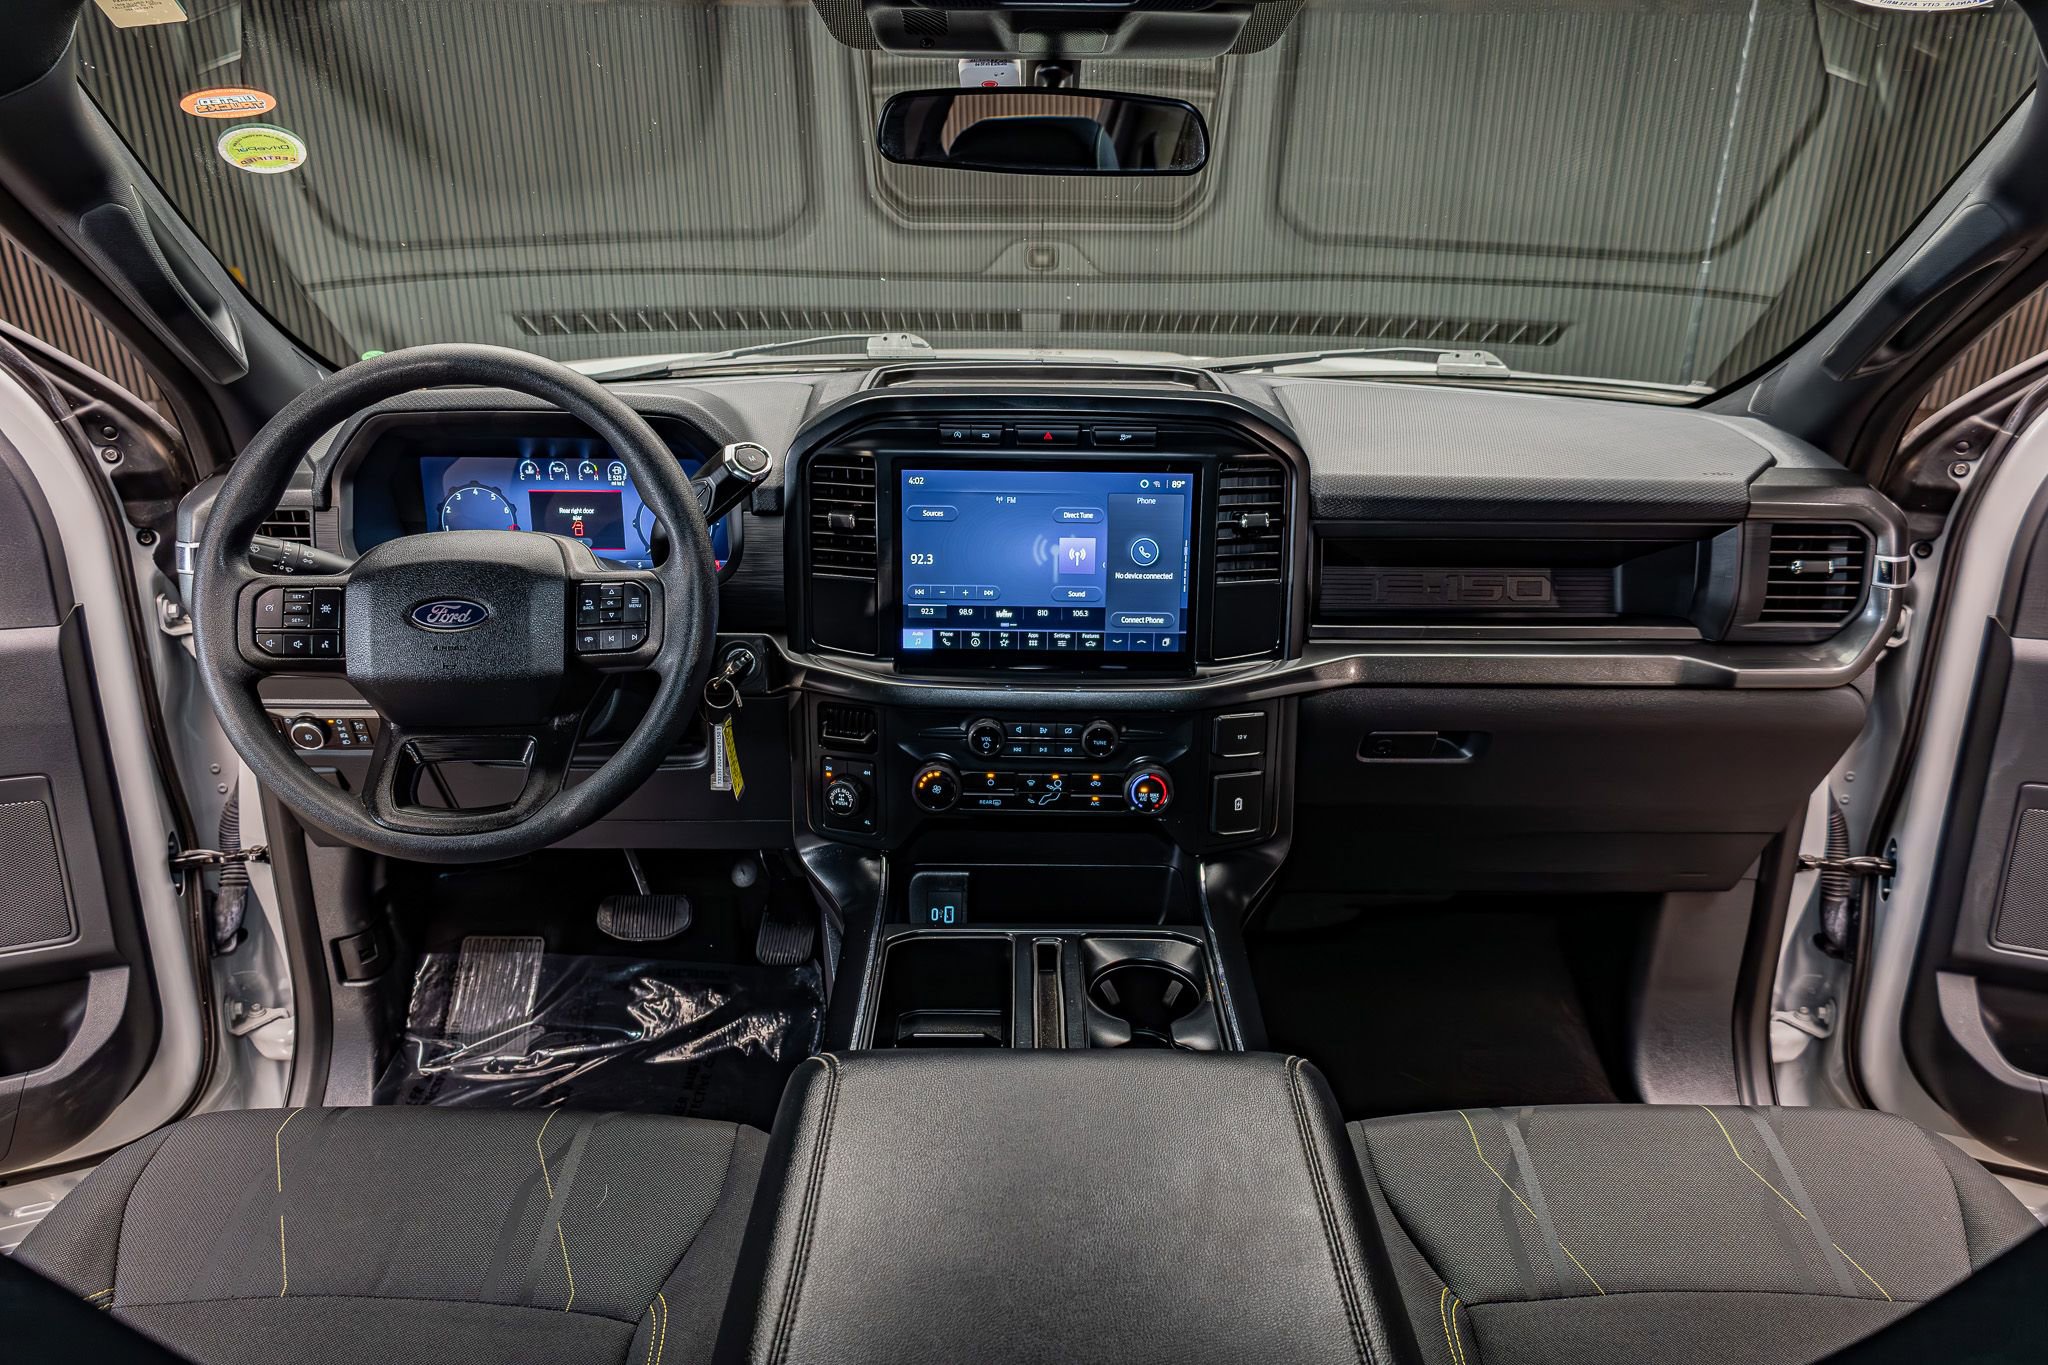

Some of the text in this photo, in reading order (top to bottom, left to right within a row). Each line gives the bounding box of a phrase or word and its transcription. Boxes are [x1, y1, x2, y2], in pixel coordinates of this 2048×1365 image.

[908, 477, 924, 486] 4:02
[473, 488, 478, 496] 4
[1006, 496, 1017, 504] FM
[1136, 497, 1156, 505] Phone
[504, 506, 509, 514] 6
[571, 507, 582, 515] right
[922, 509, 944, 518] Sources
[1063, 511, 1094, 520] Direct Tune
[910, 553, 934, 565] 92.3
[1143, 572, 1174, 580] connected
[1375, 574, 1553, 601] F-150
[1068, 590, 1086, 598] Sound
[426, 604, 473, 623] Ford
[958, 608, 973, 616] 98.9
[1037, 609, 1048, 617] 810
[1121, 616, 1145, 624] Connect
